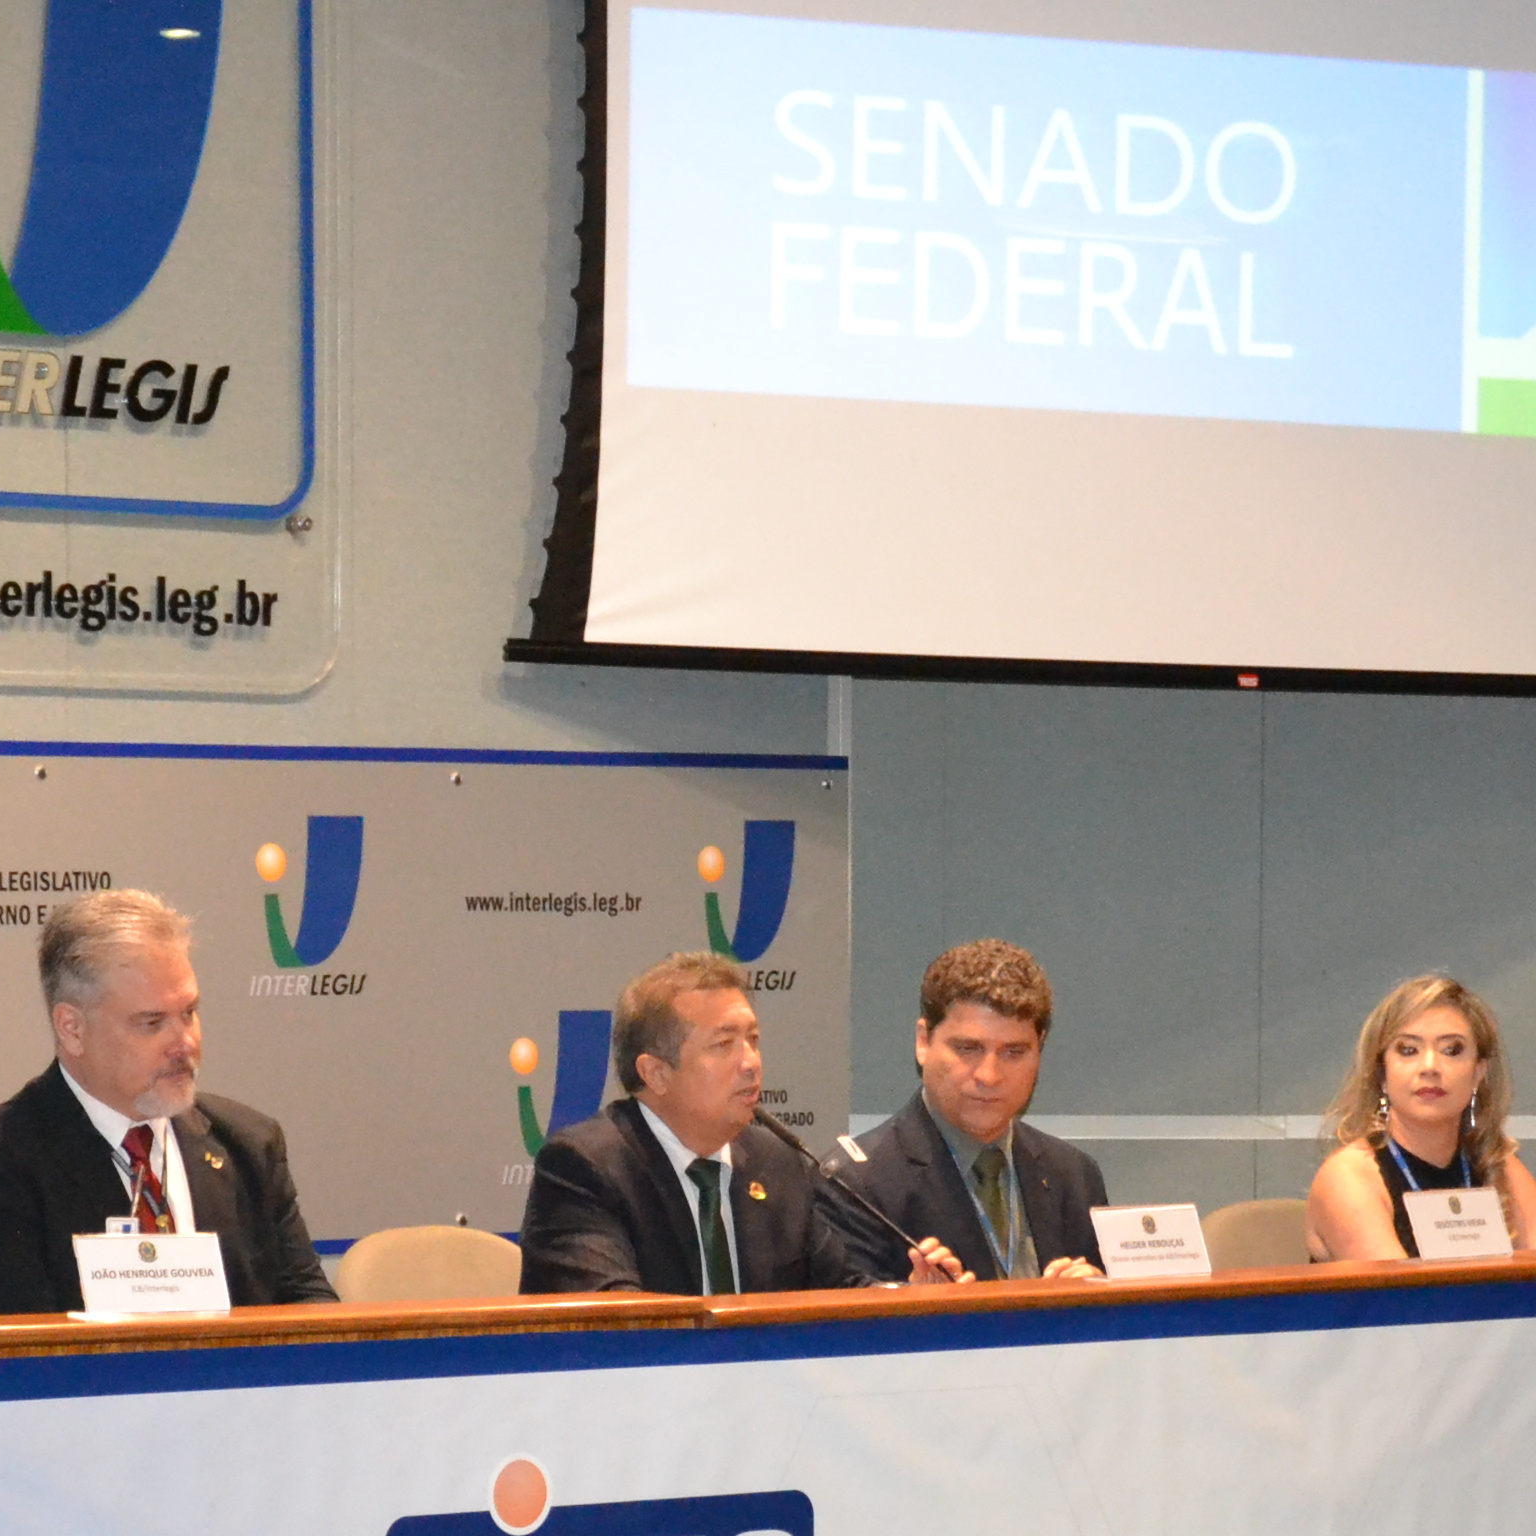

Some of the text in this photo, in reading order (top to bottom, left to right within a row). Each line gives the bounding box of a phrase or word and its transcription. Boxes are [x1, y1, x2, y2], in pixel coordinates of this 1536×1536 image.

[772, 91, 1298, 224] SENADO
[765, 221, 1297, 361] FEDERAL
[464, 891, 643, 917] www.interlegis.leg.br
[249, 974, 367, 997] INTERLEGIS
[747, 970, 797, 991] LEGIS
[91, 1267, 214, 1281] JOÃO HENRIQUE GOUVEIA
